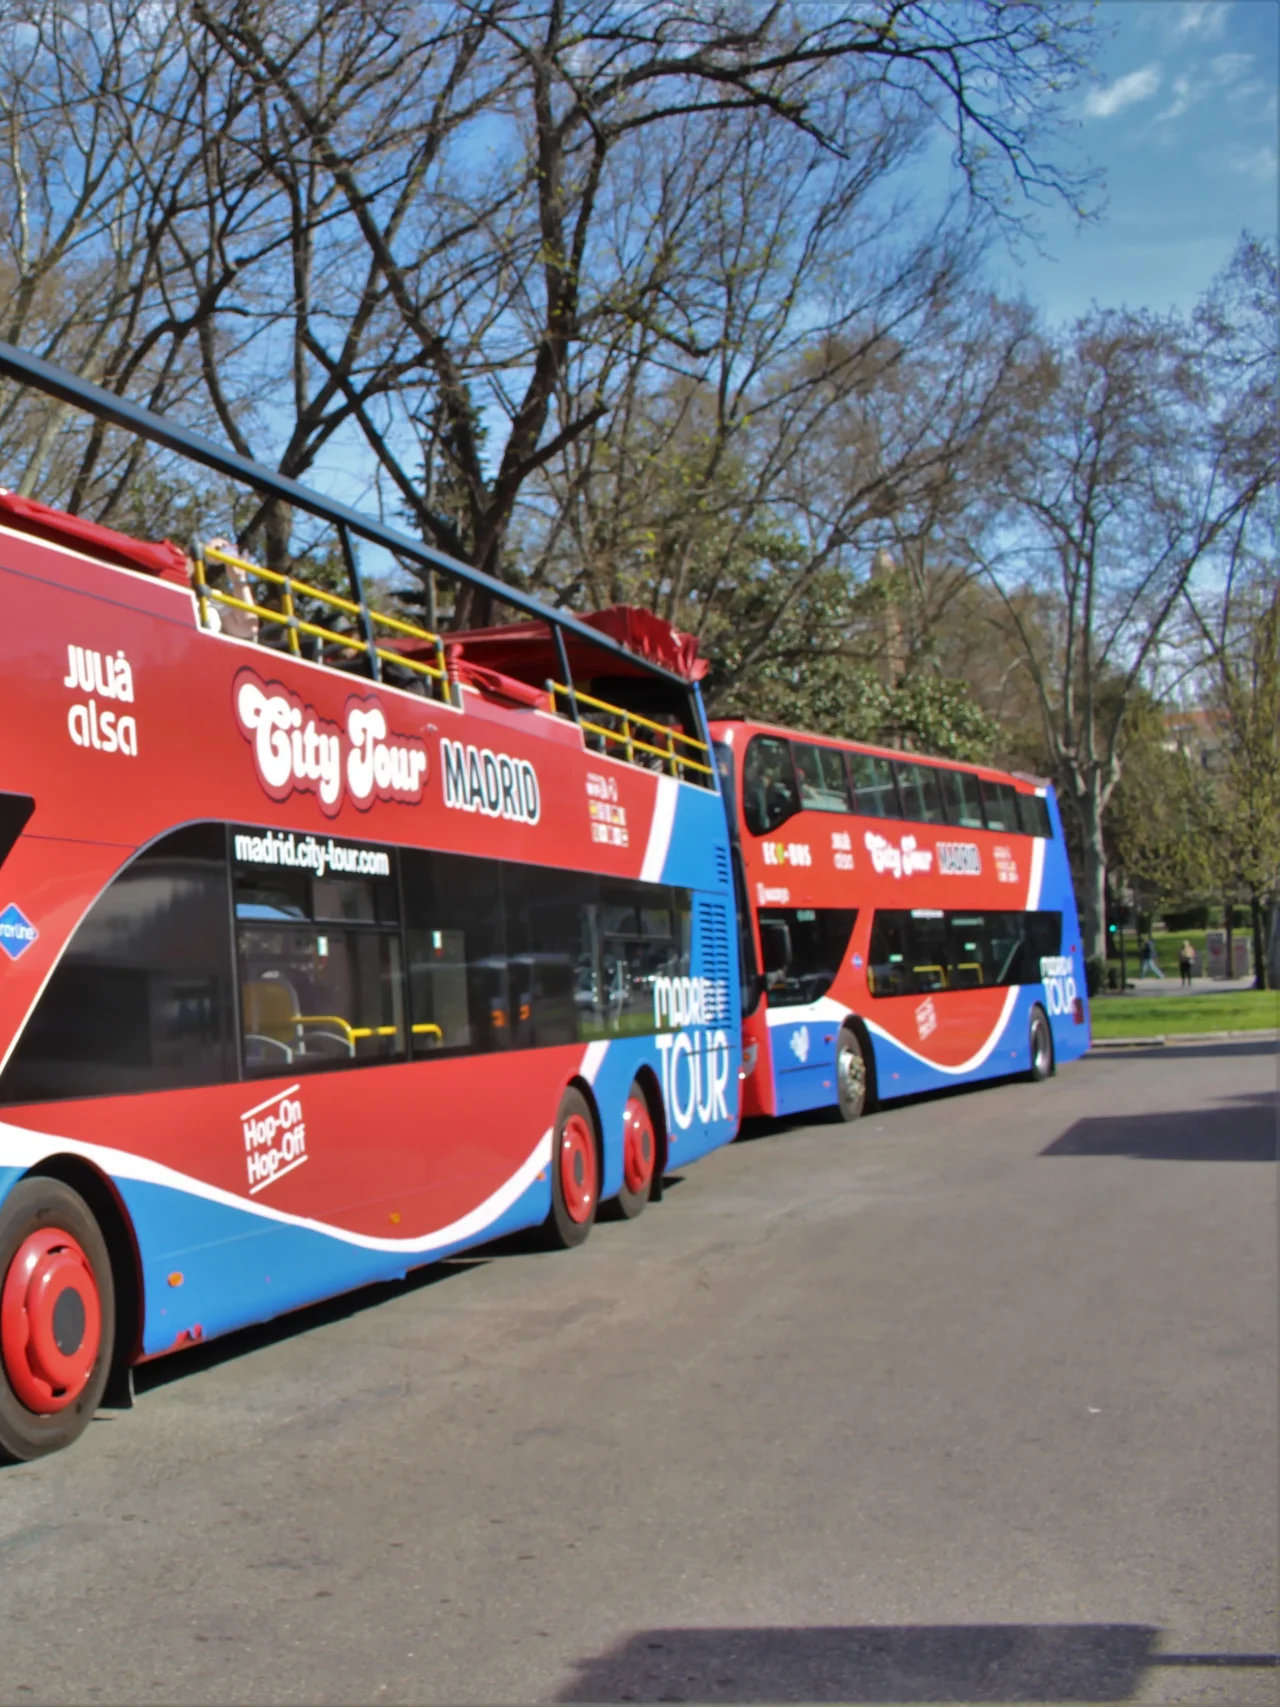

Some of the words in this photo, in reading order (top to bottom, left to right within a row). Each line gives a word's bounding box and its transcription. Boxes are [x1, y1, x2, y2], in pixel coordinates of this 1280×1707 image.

[67, 698, 139, 757] alsa
[238, 683, 340, 804] City
[347, 708, 427, 799] Tour
[440, 737, 541, 827] MADRID
[234, 831, 391, 878] madrid.city-tour.com
[654, 1029, 730, 1135] TOUR
[243, 1099, 303, 1151] Hop-On
[246, 1123, 306, 1184] Hop-Off
